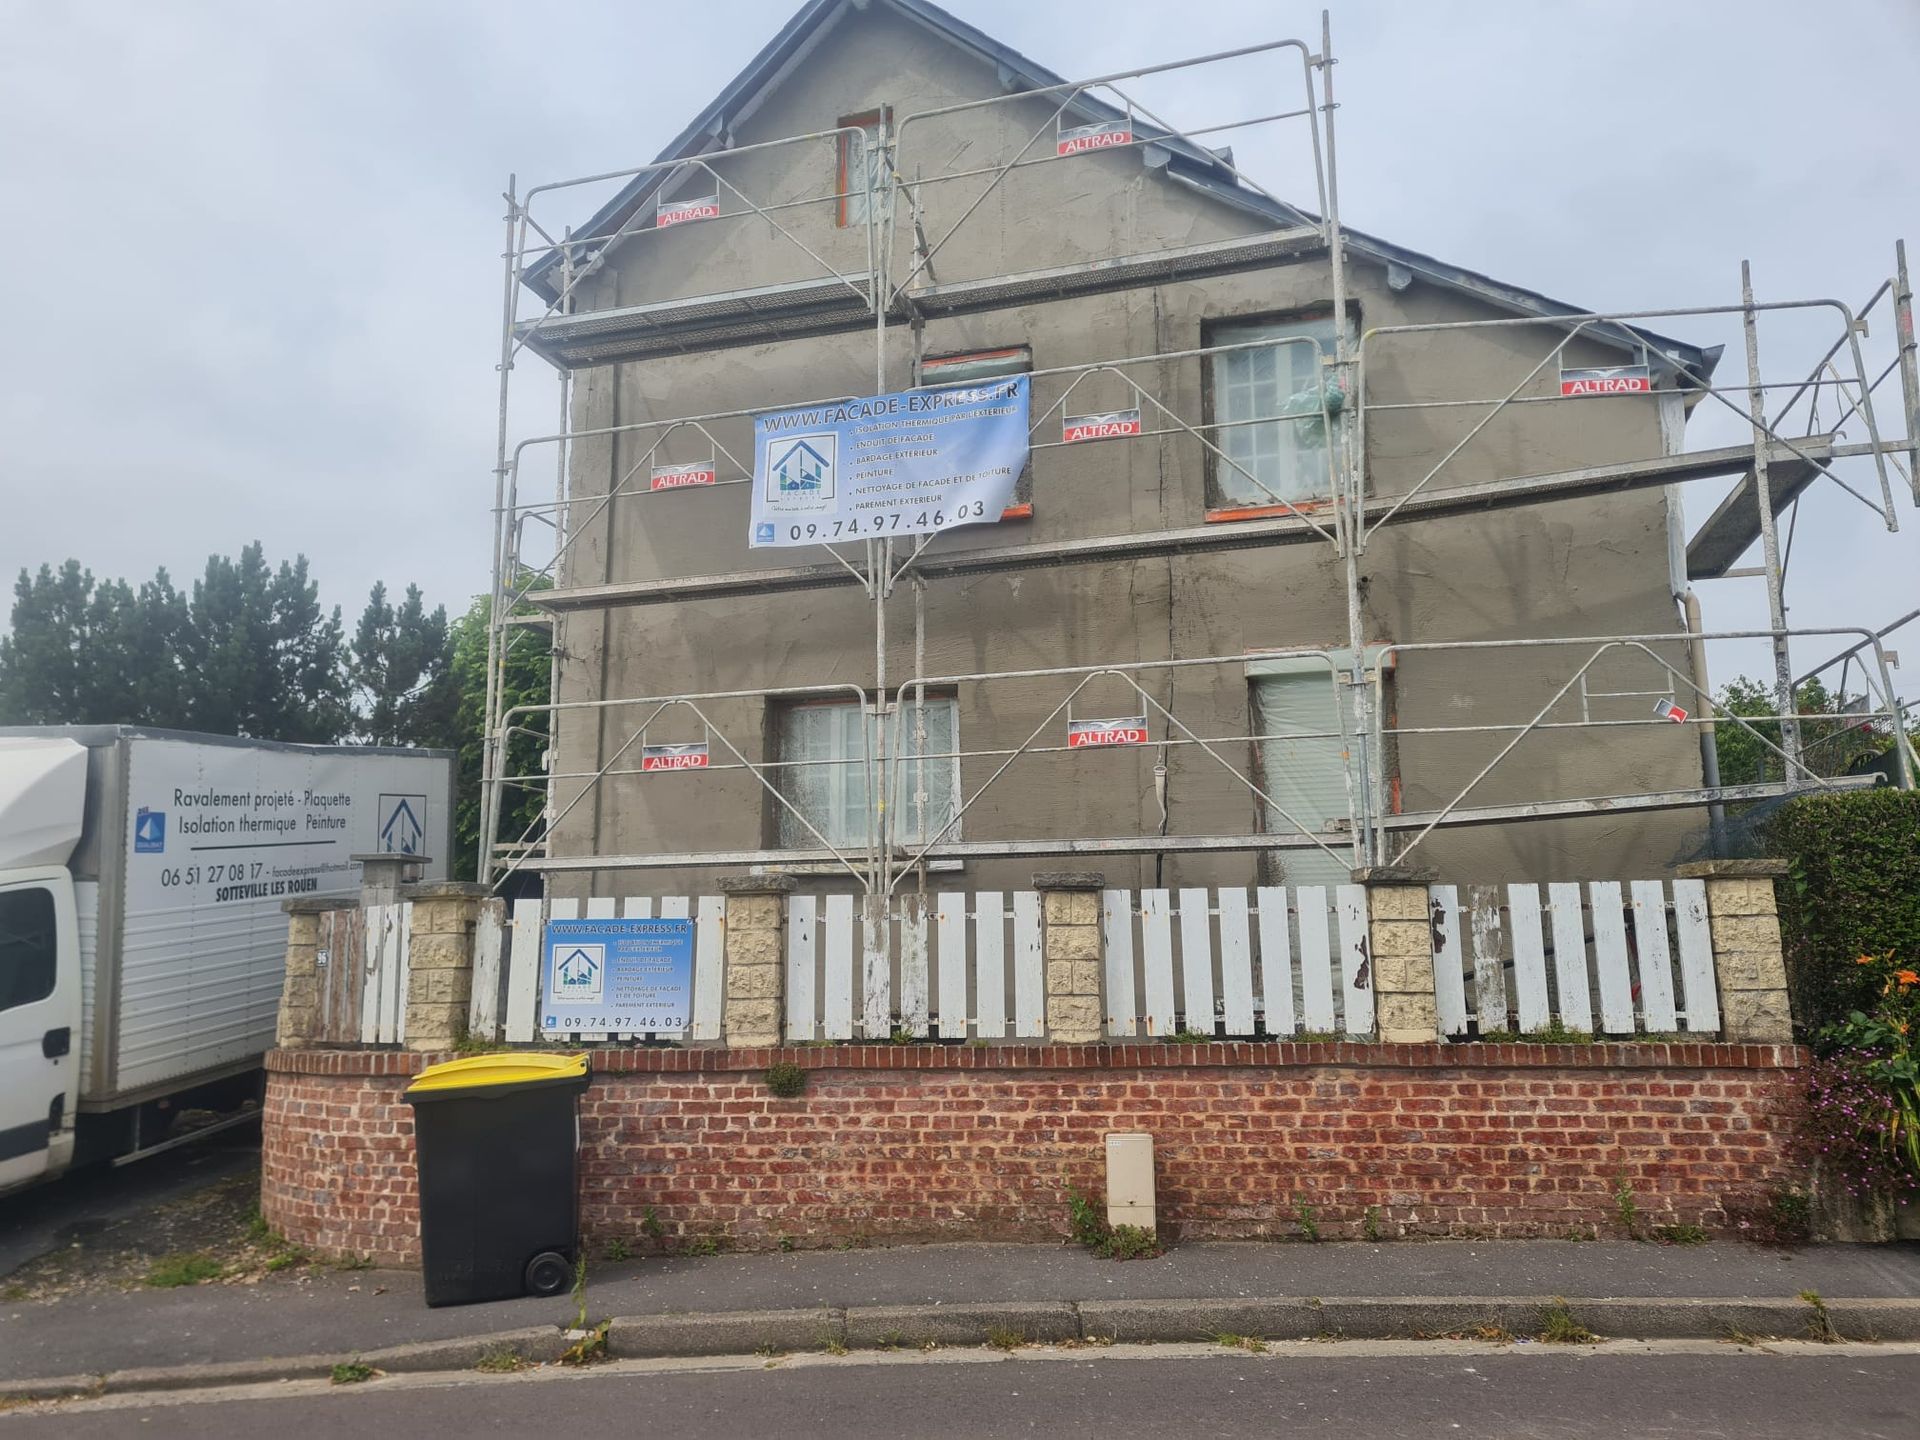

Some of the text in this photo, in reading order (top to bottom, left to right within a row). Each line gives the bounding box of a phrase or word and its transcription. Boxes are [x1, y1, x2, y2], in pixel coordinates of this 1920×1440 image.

[1065, 132, 1124, 153] ALTRAD
[664, 206, 713, 226] ALTRAD
[1570, 379, 1642, 394] ALTRAD
[764, 383, 1019, 433] WWW.FACADE-EXPRESS.FR
[855, 421, 898, 434] ISOLATION
[901, 416, 949, 429] THERMIQUE
[1071, 422, 1133, 440] ALTRAD
[856, 433, 934, 449] ENDUIT DE FACADE
[856, 448, 938, 465] BARDAGE EXTERIEUR
[657, 472, 708, 489] ALTRAD
[856, 468, 893, 480] PEINTURE
[855, 483, 902, 495] NETTOYAGE
[905, 481, 916, 490] DE
[918, 478, 951, 488] FACADE
[953, 476, 963, 484] ET
[965, 474, 976, 483] DE
[855, 494, 942, 510] PAREMENT EXTERIEUR
[790, 500, 984, 541] 09.74.97.46.03
[1077, 730, 1140, 746] ALTRAD
[650, 755, 701, 769] ALTRAD
[174, 788, 251, 807] Ravalement
[254, 790, 294, 812] projeté
[304, 789, 351, 812] Plaquette
[179, 813, 346, 835] Isolation thermique Peinture
[162, 868, 180, 887] 06
[185, 867, 200, 884] 51
[208, 866, 224, 883] 27
[228, 864, 244, 882] 08
[251, 862, 263, 880] 17
[216, 877, 318, 902] SOTTEVILLE LES ROUEN
[564, 1017, 682, 1027] 09.74.97.46.03
